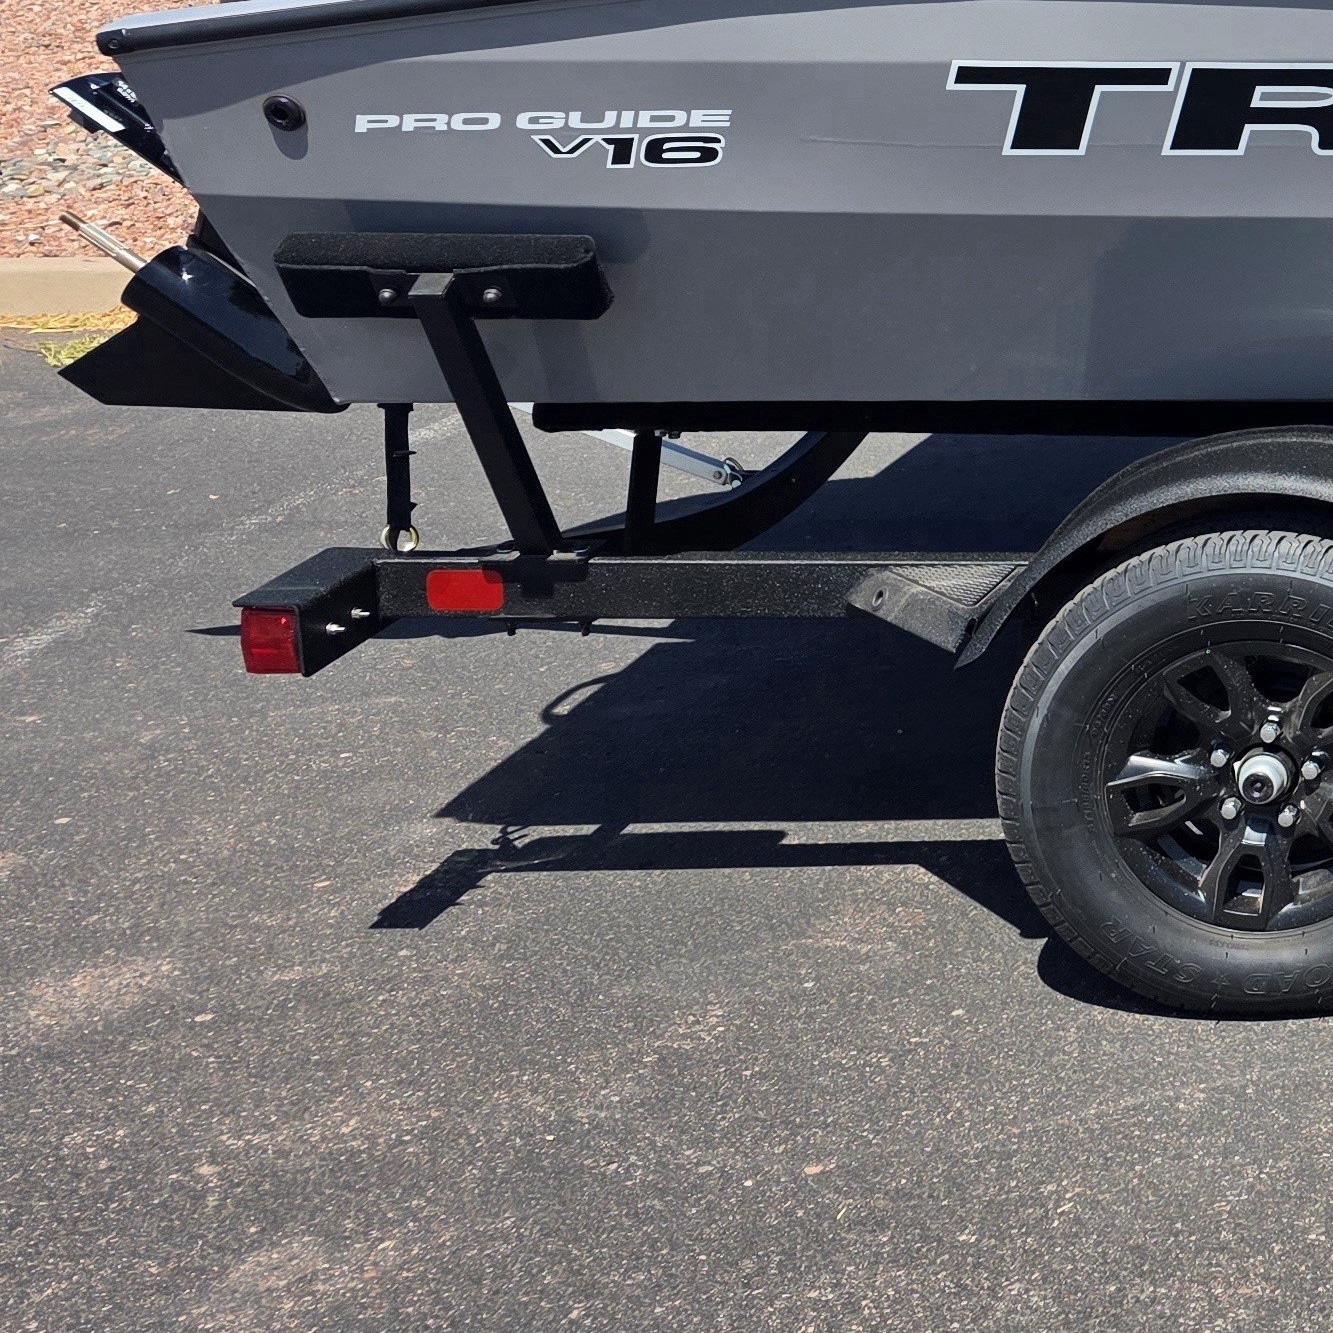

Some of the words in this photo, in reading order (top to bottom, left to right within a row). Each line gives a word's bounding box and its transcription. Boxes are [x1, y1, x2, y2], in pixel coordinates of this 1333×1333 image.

[354, 112, 501, 132] PRO
[516, 109, 733, 130] GUIDE
[531, 132, 726, 168] V16
[1100, 919, 1202, 983] STAR
